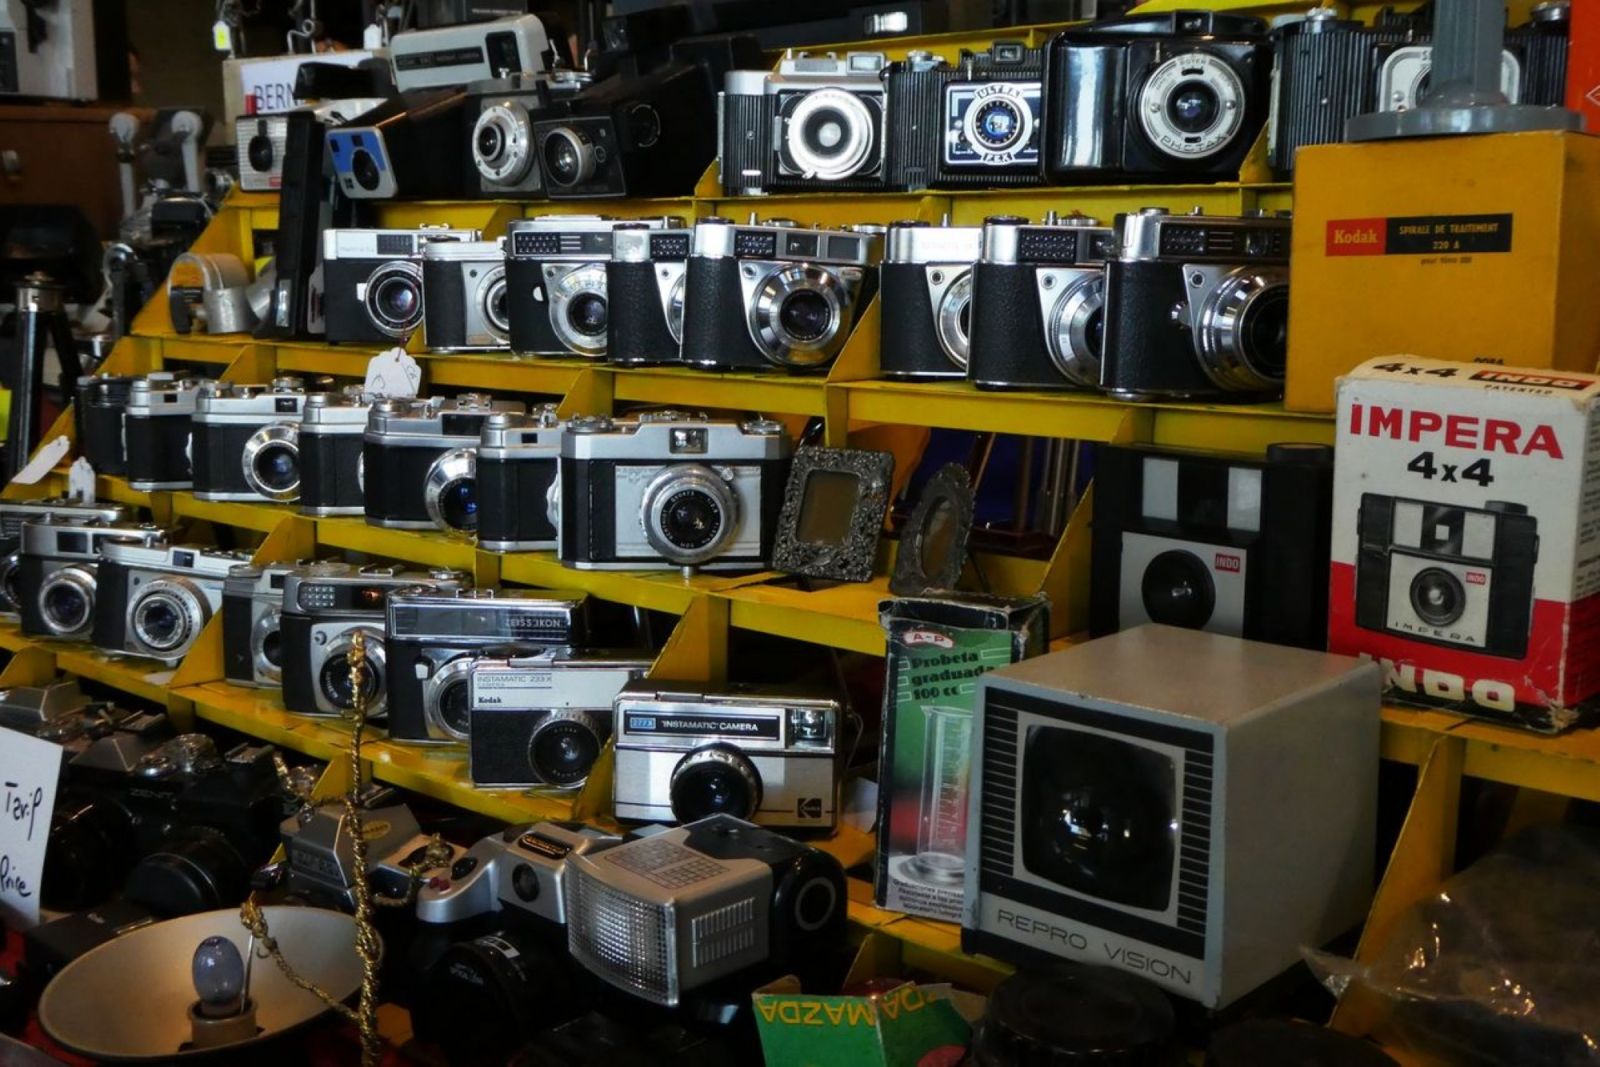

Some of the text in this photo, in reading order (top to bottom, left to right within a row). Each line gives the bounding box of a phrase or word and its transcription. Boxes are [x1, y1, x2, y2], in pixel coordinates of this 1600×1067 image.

[1334, 229, 1378, 244] Kodak
[1373, 362, 1582, 388] 4x4 INDO
[1484, 384, 1553, 395] PATENTED
[1350, 403, 1564, 460] IMPERA
[1407, 451, 1494, 487] 4x4
[1216, 555, 1239, 569] INDO
[1467, 573, 1485, 584] INDO
[1394, 621, 1475, 642] IMPERA
[911, 652, 979, 669] Probeta
[1360, 652, 1515, 712] NDO
[478, 696, 502, 704] Kodak
[913, 687, 939, 700] 100
[719, 722, 758, 732] CAMERA
[997, 909, 1191, 984] REPRO VISION
[755, 1001, 876, 1026] MAZDA
